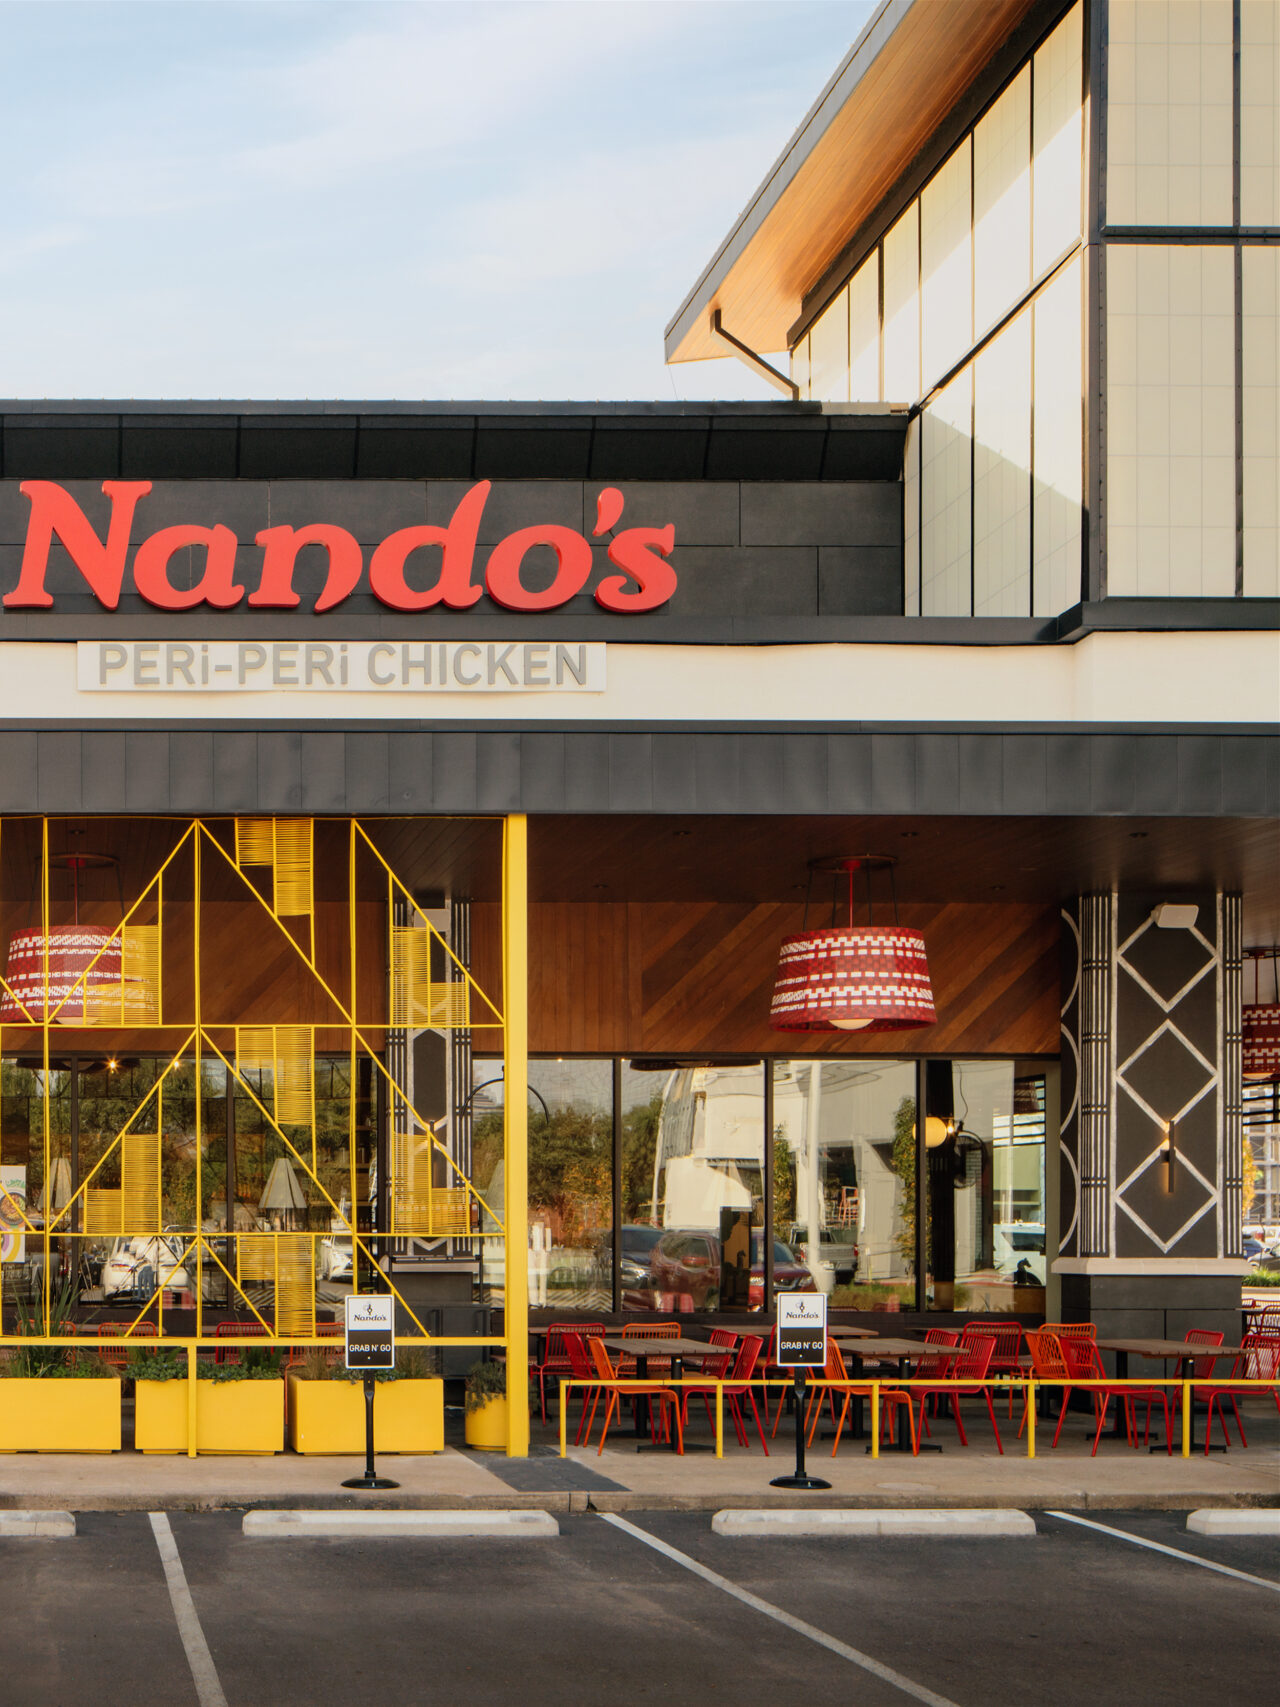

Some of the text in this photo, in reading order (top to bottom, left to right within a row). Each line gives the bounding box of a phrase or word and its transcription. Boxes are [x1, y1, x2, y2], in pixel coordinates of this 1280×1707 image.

[3, 480, 678, 613] Nando's
[99, 643, 588, 686] PERi-PERi CHICKEN
[353, 1314, 387, 1322] Nando's
[786, 1311, 819, 1319] Nando's
[349, 1344, 392, 1352] GRAB N' GO
[780, 1341, 824, 1350] GRAB N' GO
